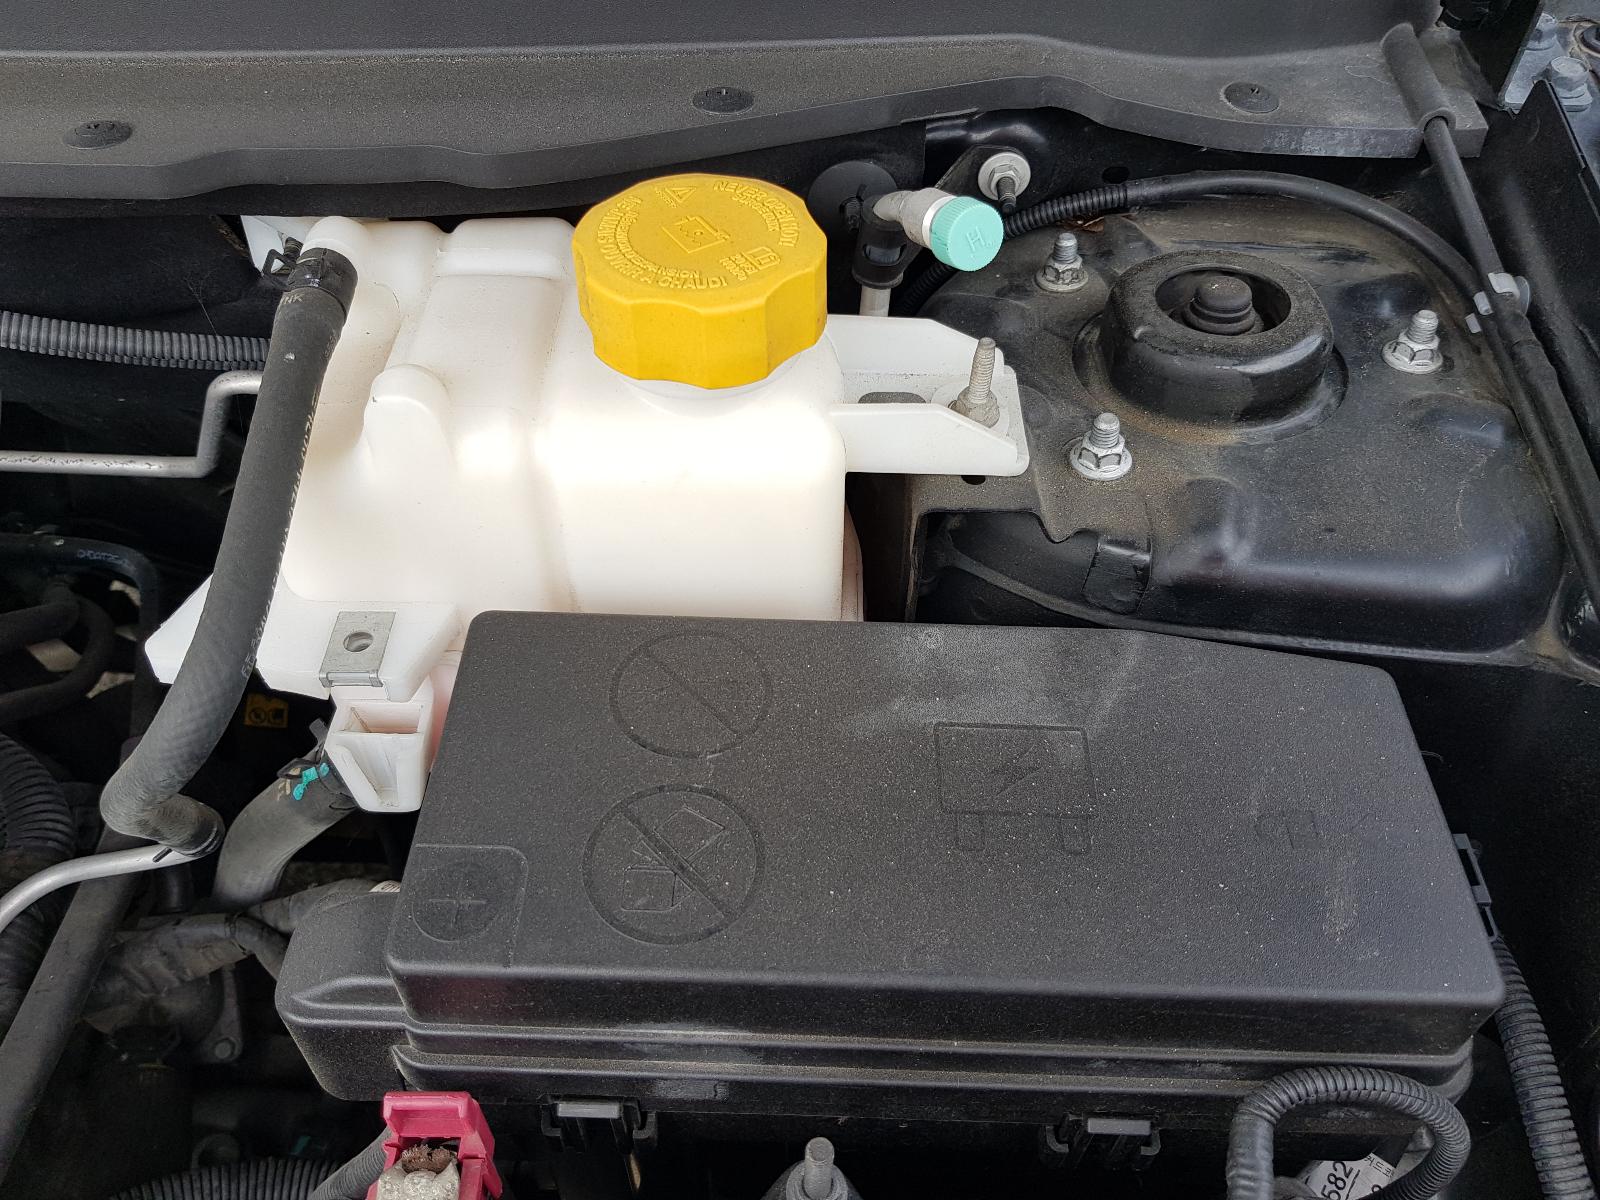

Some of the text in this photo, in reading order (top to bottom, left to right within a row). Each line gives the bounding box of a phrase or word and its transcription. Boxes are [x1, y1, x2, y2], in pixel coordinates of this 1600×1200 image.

[597, 207, 624, 243] JAMAIS
[713, 180, 799, 247] NEVER OPEN HOT!
[966, 226, 985, 252] H
[600, 244, 642, 278] OUVRIR
[657, 272, 726, 289] CHAUD!
